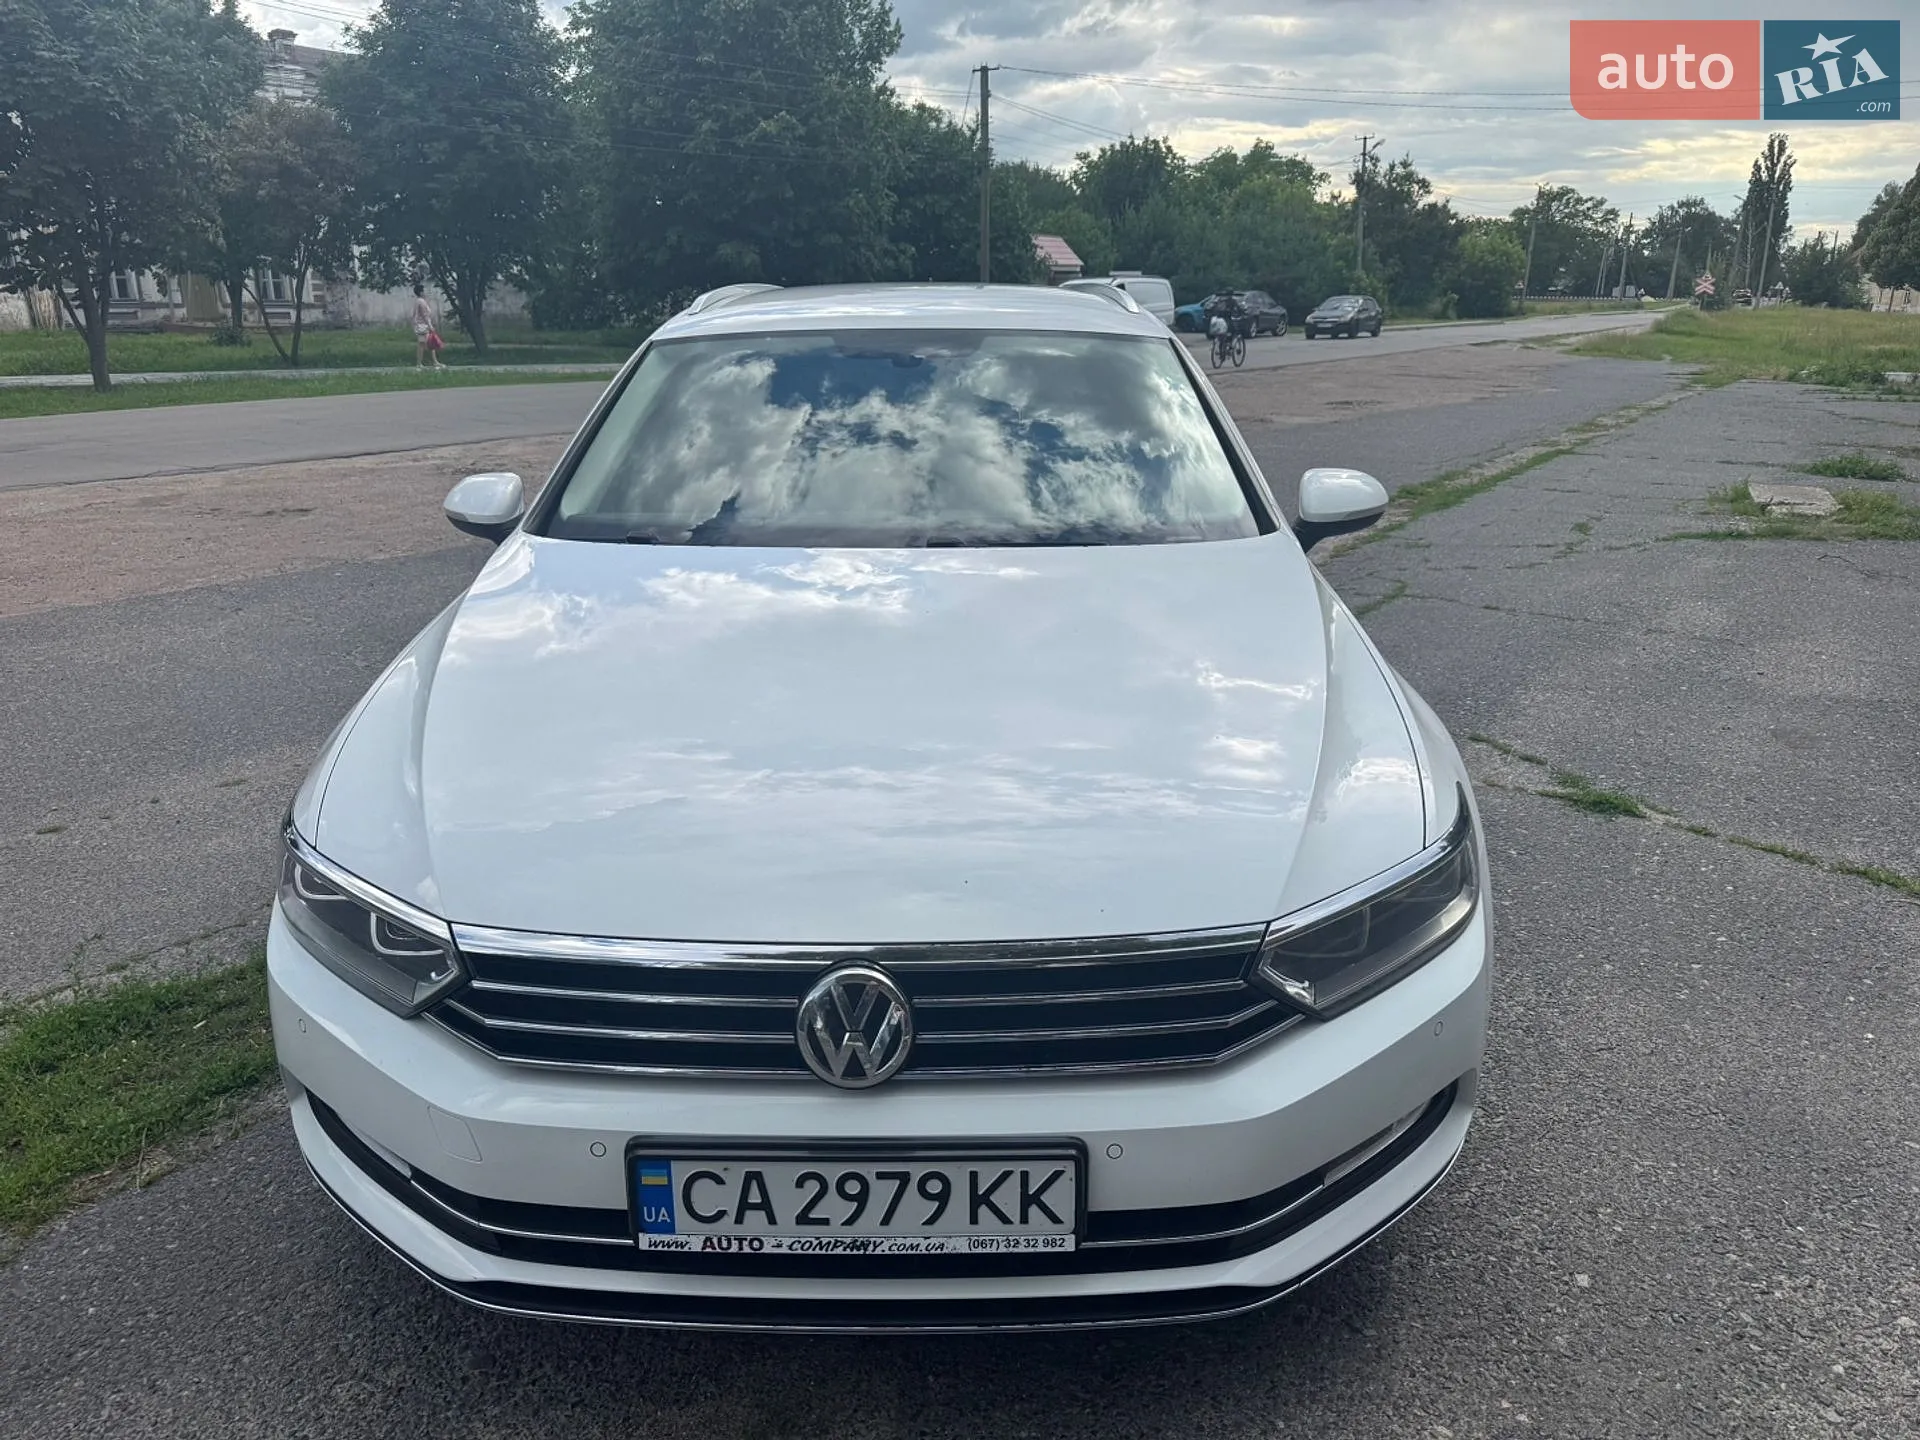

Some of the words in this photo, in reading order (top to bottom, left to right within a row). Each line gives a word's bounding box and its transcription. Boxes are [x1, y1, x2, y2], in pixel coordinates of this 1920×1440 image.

[681, 1170, 778, 1226] CA
[794, 1170, 952, 1227] 2979
[968, 1169, 1067, 1225] KK
[643, 1206, 671, 1223] UA
[967, 1238, 1000, 1251] (067)
[1023, 1238, 1040, 1249] 32
[1042, 1237, 1066, 1248] 982
